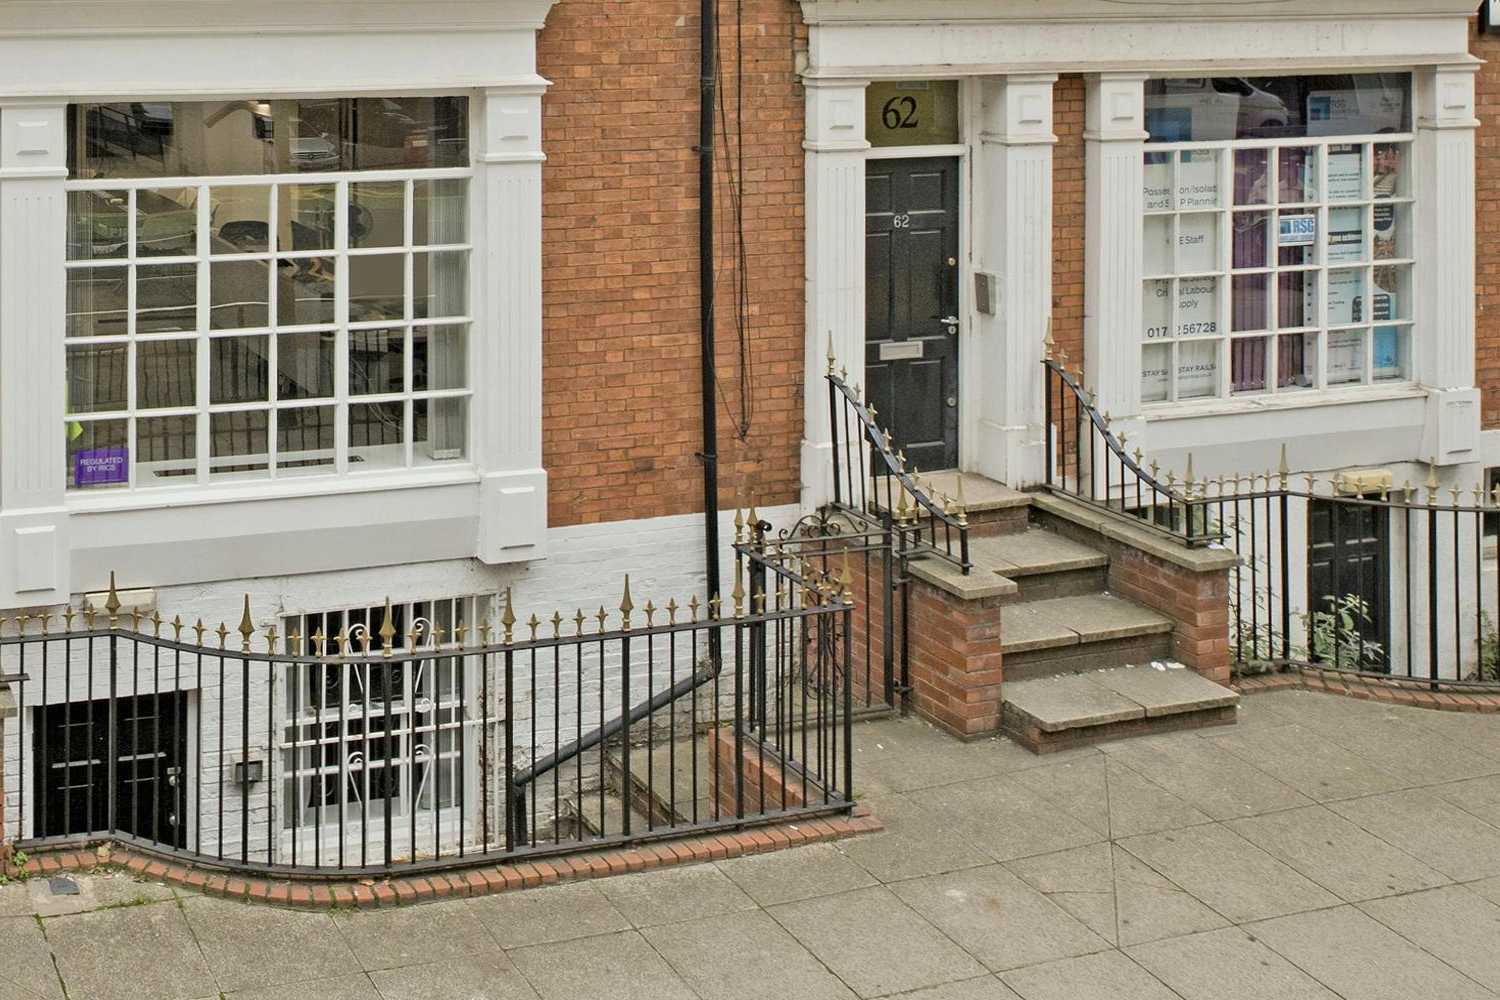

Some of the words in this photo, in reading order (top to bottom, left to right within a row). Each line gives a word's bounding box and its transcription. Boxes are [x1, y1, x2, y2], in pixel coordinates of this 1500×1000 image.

[881, 96, 919, 130] 62
[893, 215, 910, 228] 62
[1293, 219, 1314, 233] RSG
[1186, 286, 1217, 295] Labour
[80, 457, 123, 466] REGULATED
